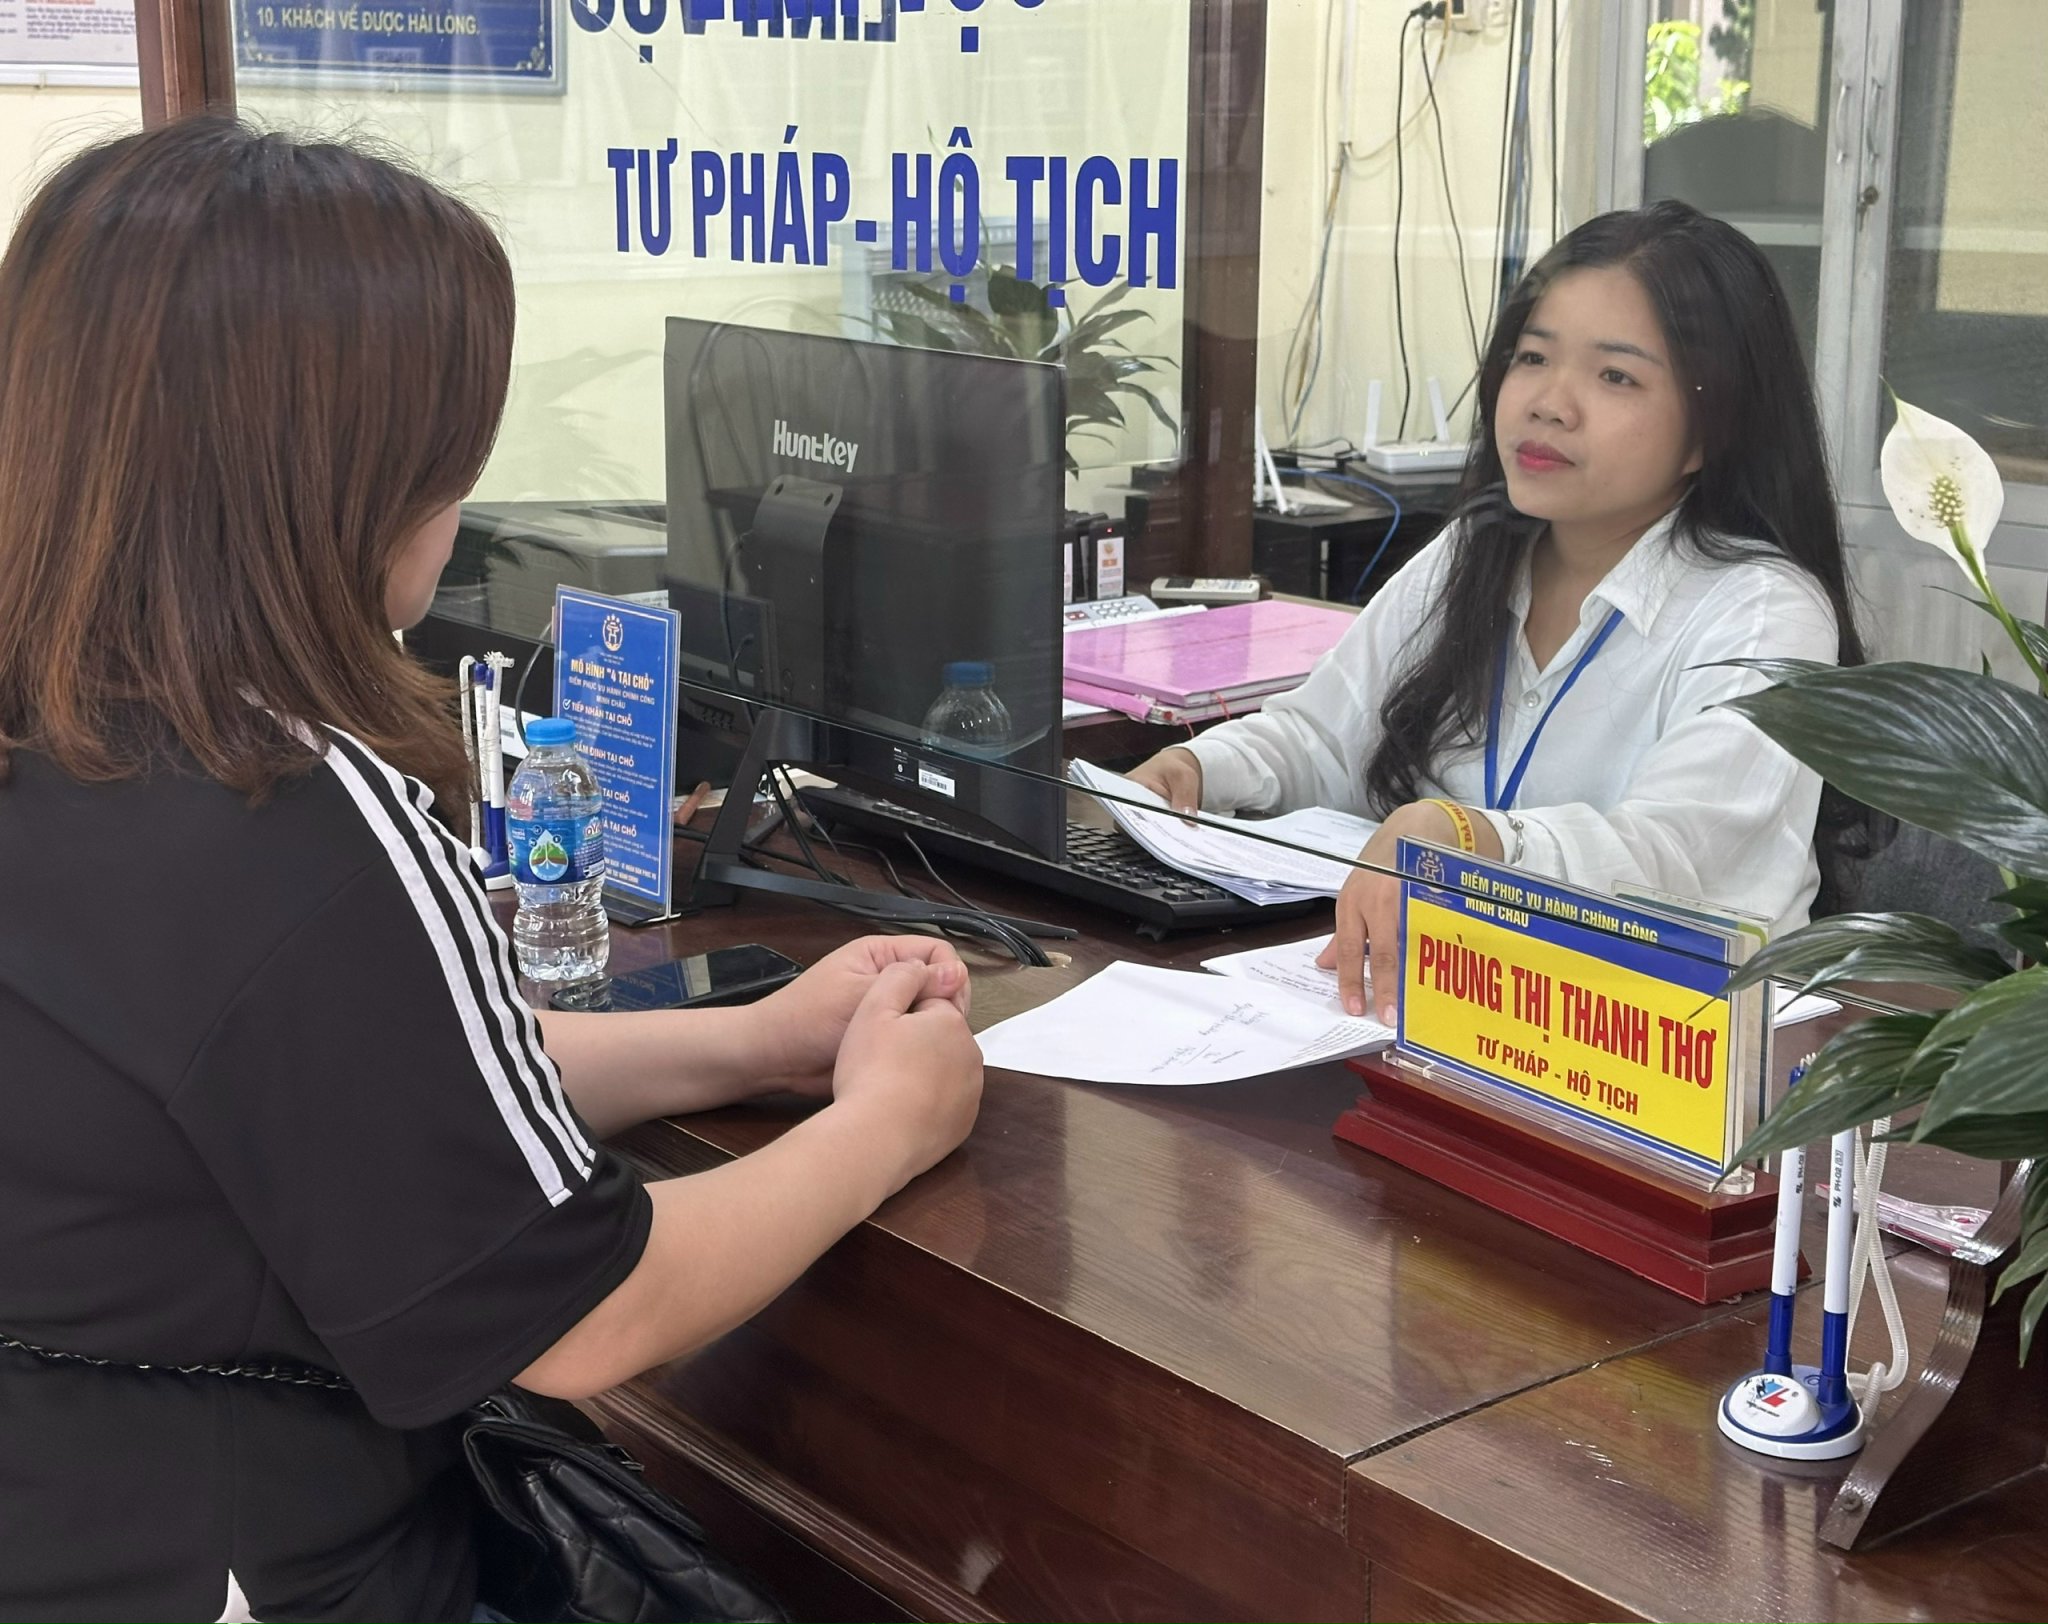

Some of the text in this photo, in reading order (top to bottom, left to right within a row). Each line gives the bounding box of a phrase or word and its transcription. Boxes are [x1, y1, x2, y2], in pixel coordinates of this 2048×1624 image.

[257, 7, 278, 28] 10.
[281, 4, 335, 30] KHÁCH
[362, 9, 404, 37] ĐƯỢC
[607, 138, 678, 256] TƯ
[892, 127, 980, 303] HỘ
[1006, 155, 1178, 308] TỊCH
[570, 658, 584, 674] MÔ
[585, 661, 605, 679] HÌNH
[618, 671, 631, 688] TẠI
[571, 701, 584, 712] TIẾP
[605, 711, 616, 725] TẠI
[573, 740, 588, 755] HẨM
[607, 751, 617, 765] TẠI
[603, 787, 613, 800] TẠI
[610, 820, 620, 834] TẠI
[1460, 869, 1489, 894] ĐIỂM
[1545, 896, 1578, 920] HÀNH
[1582, 910, 1619, 933] CHÍNH
[1622, 920, 1658, 943] CÔNG
[1465, 897, 1495, 917] MINH
[1418, 934, 1502, 1014] PHÙNG
[1511, 965, 1551, 1044] THỊ
[1560, 981, 1649, 1067] THANH
[1659, 1015, 1717, 1089] THƠ
[1476, 1034, 1500, 1060] TƯ
[1502, 1044, 1549, 1080] PHÁP
[1567, 1069, 1591, 1101] HỘ
[1597, 1080, 1639, 1116] TỊCH
